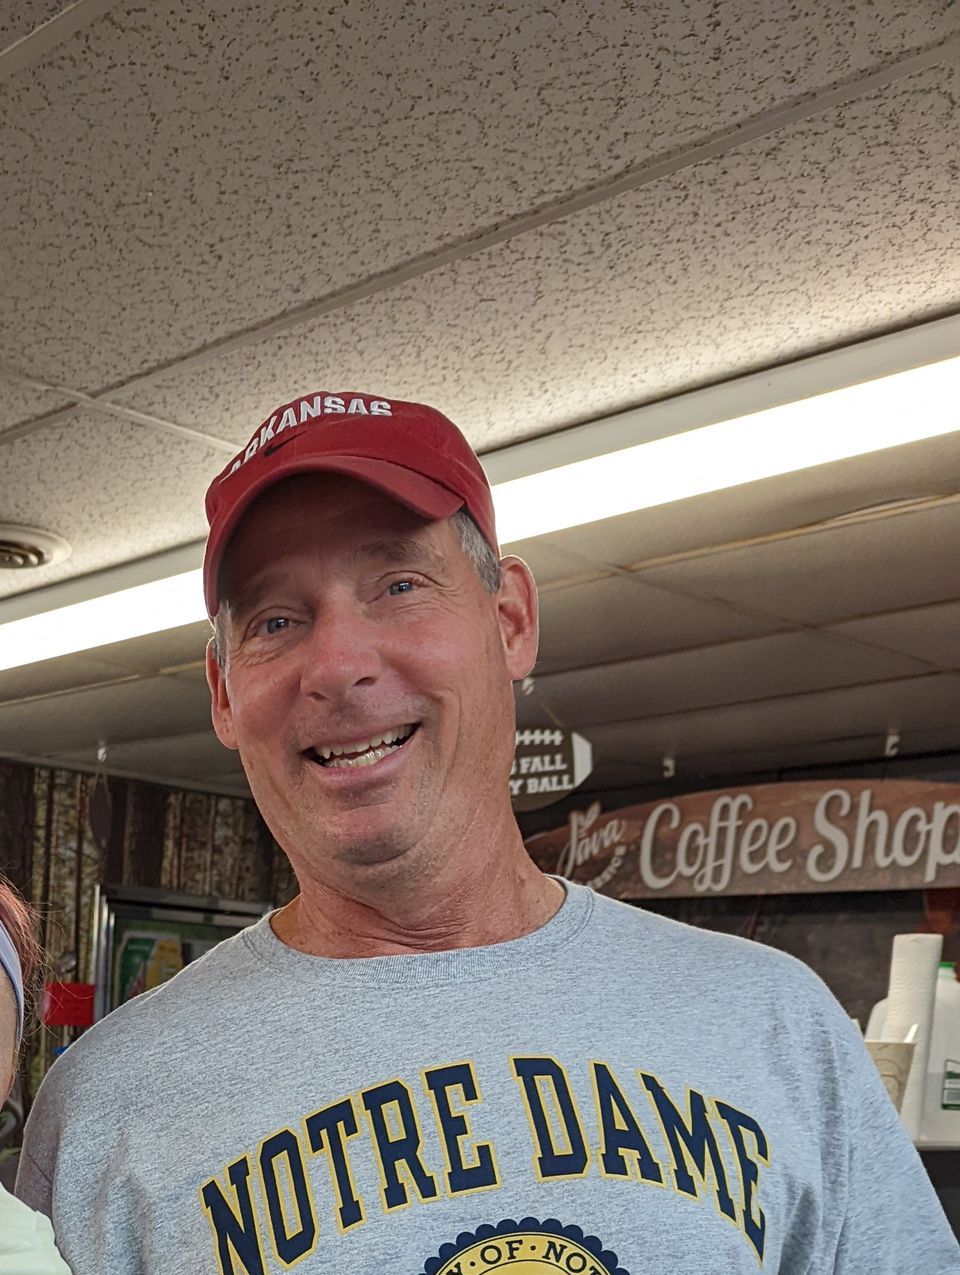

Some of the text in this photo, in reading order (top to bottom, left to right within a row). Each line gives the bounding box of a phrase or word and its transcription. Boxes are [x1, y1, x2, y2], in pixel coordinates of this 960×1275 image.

[219, 396, 392, 485] ARKANSAS
[520, 754, 568, 774] FALL
[526, 774, 575, 794] BALL
[640, 793, 797, 891] Coffee
[806, 788, 960, 882] Shop
[510, 1055, 773, 1269] DAME
[480, 1239, 523, 1265] OF
